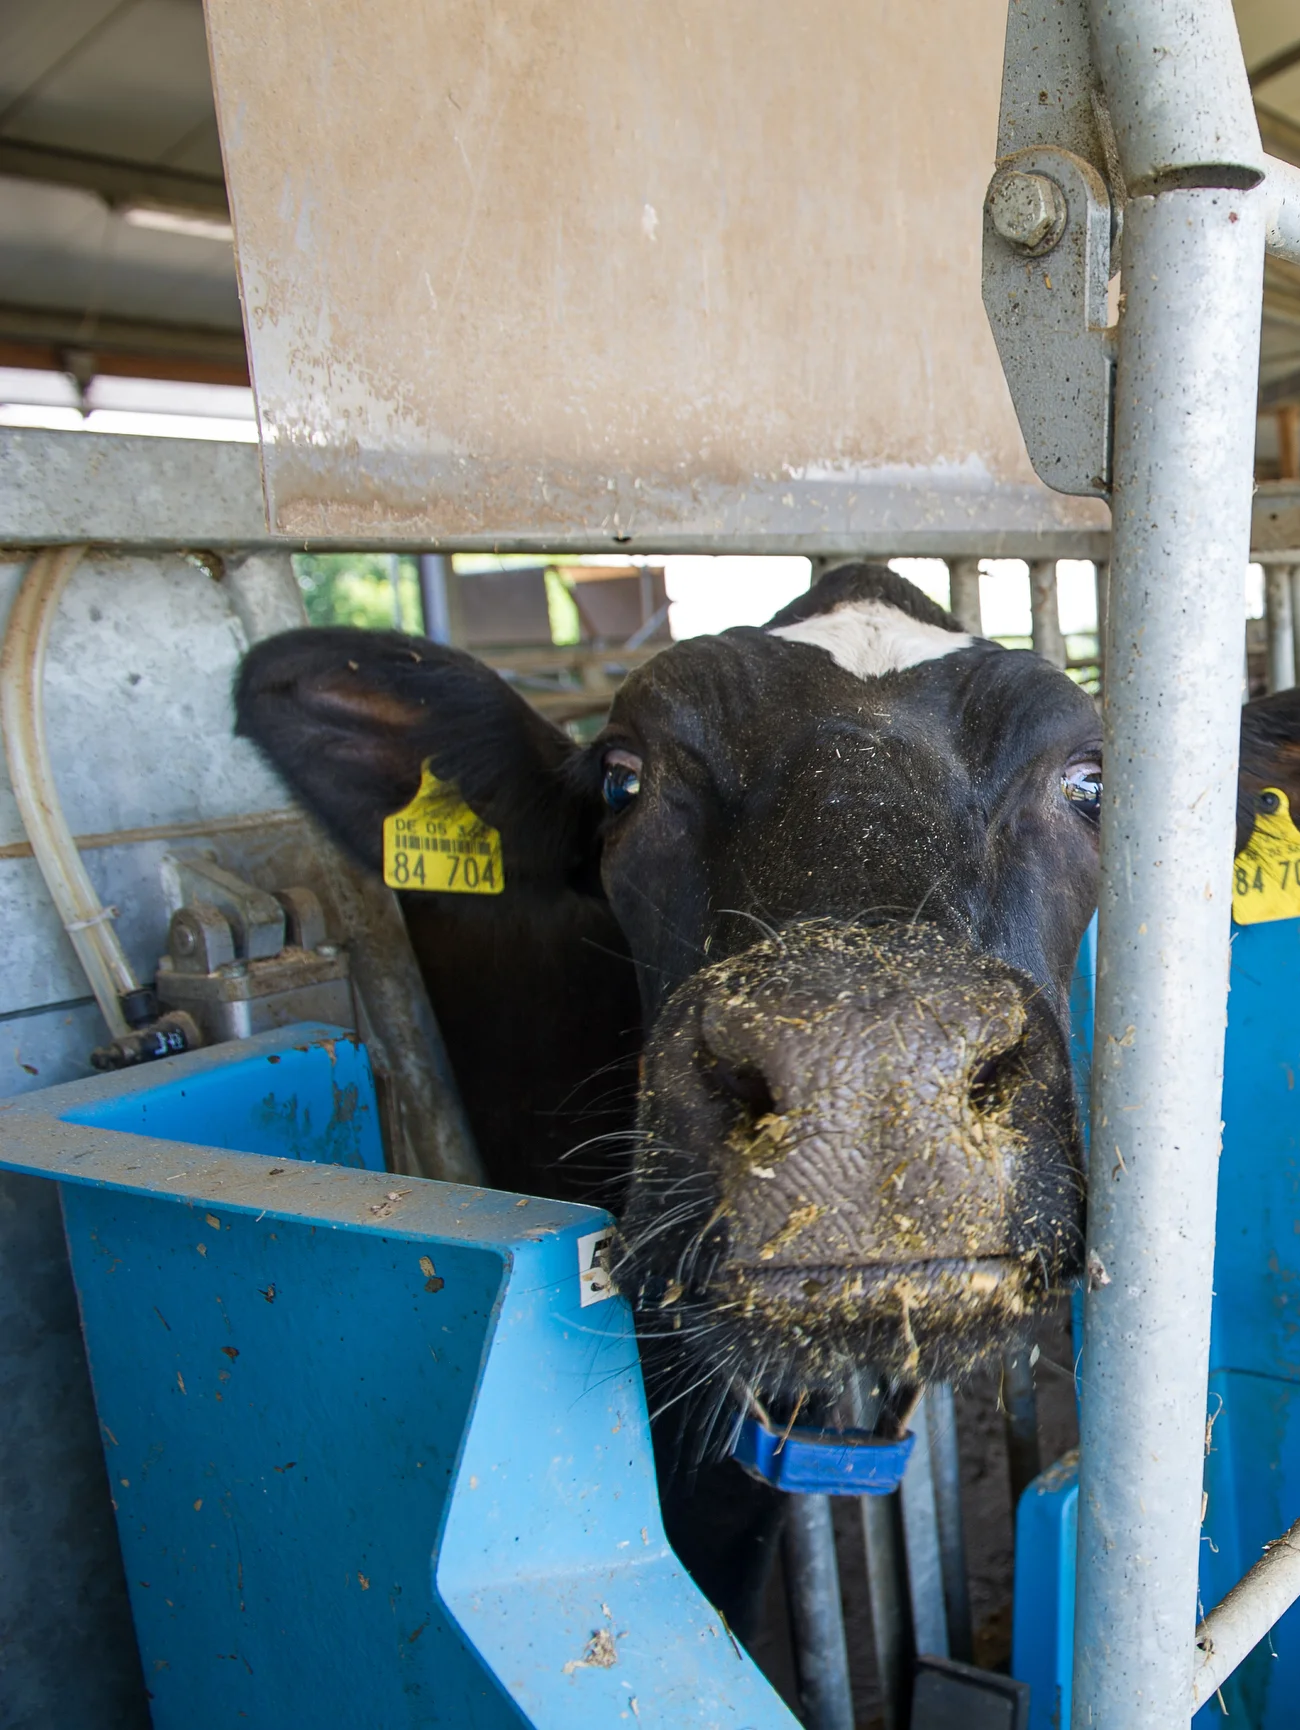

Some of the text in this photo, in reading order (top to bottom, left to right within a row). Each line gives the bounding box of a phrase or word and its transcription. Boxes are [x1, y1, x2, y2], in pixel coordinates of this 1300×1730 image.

[395, 819, 417, 834] DE
[394, 852, 495, 889] 84 704
[1235, 866, 1264, 896] 84
